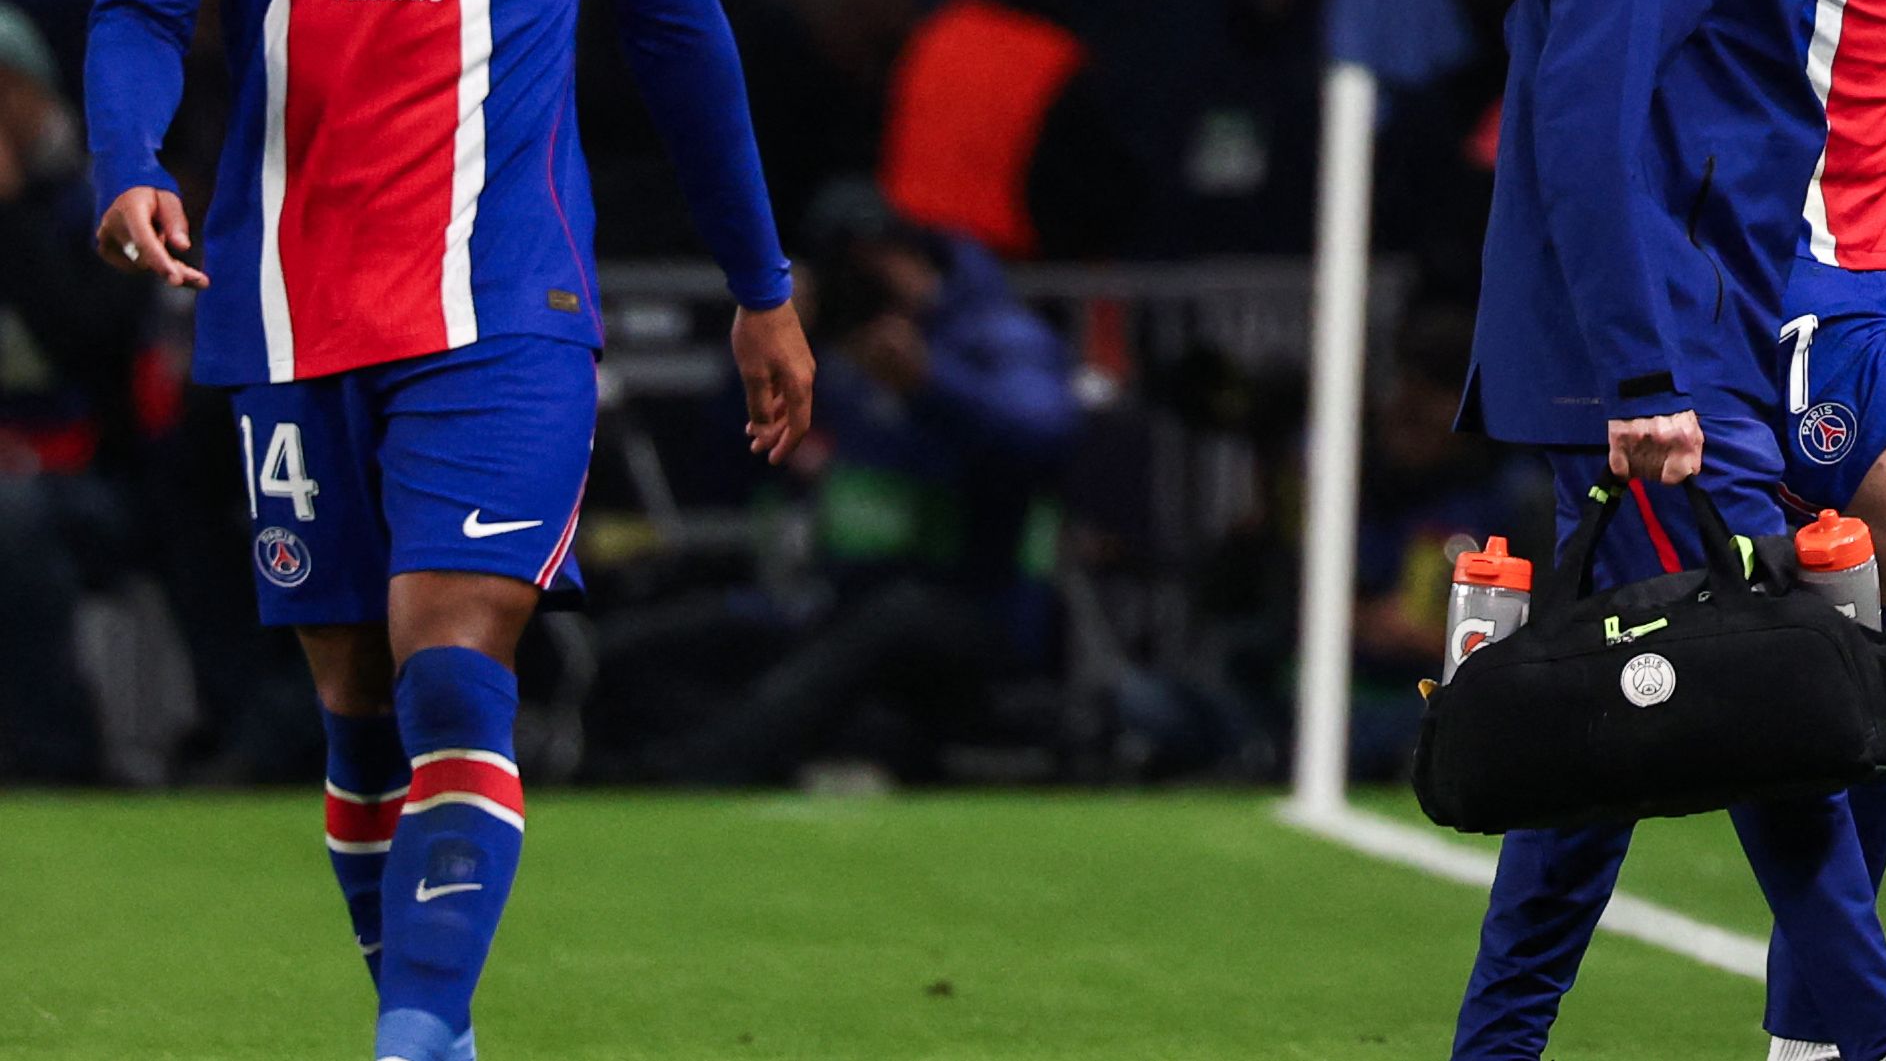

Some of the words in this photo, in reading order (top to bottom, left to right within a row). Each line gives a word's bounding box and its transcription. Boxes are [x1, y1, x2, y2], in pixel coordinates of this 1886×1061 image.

[1802, 405, 1833, 435] PARIS
[241, 414, 320, 521] 14
[259, 529, 297, 546] PARIS
[1630, 656, 1663, 671] PARIS
